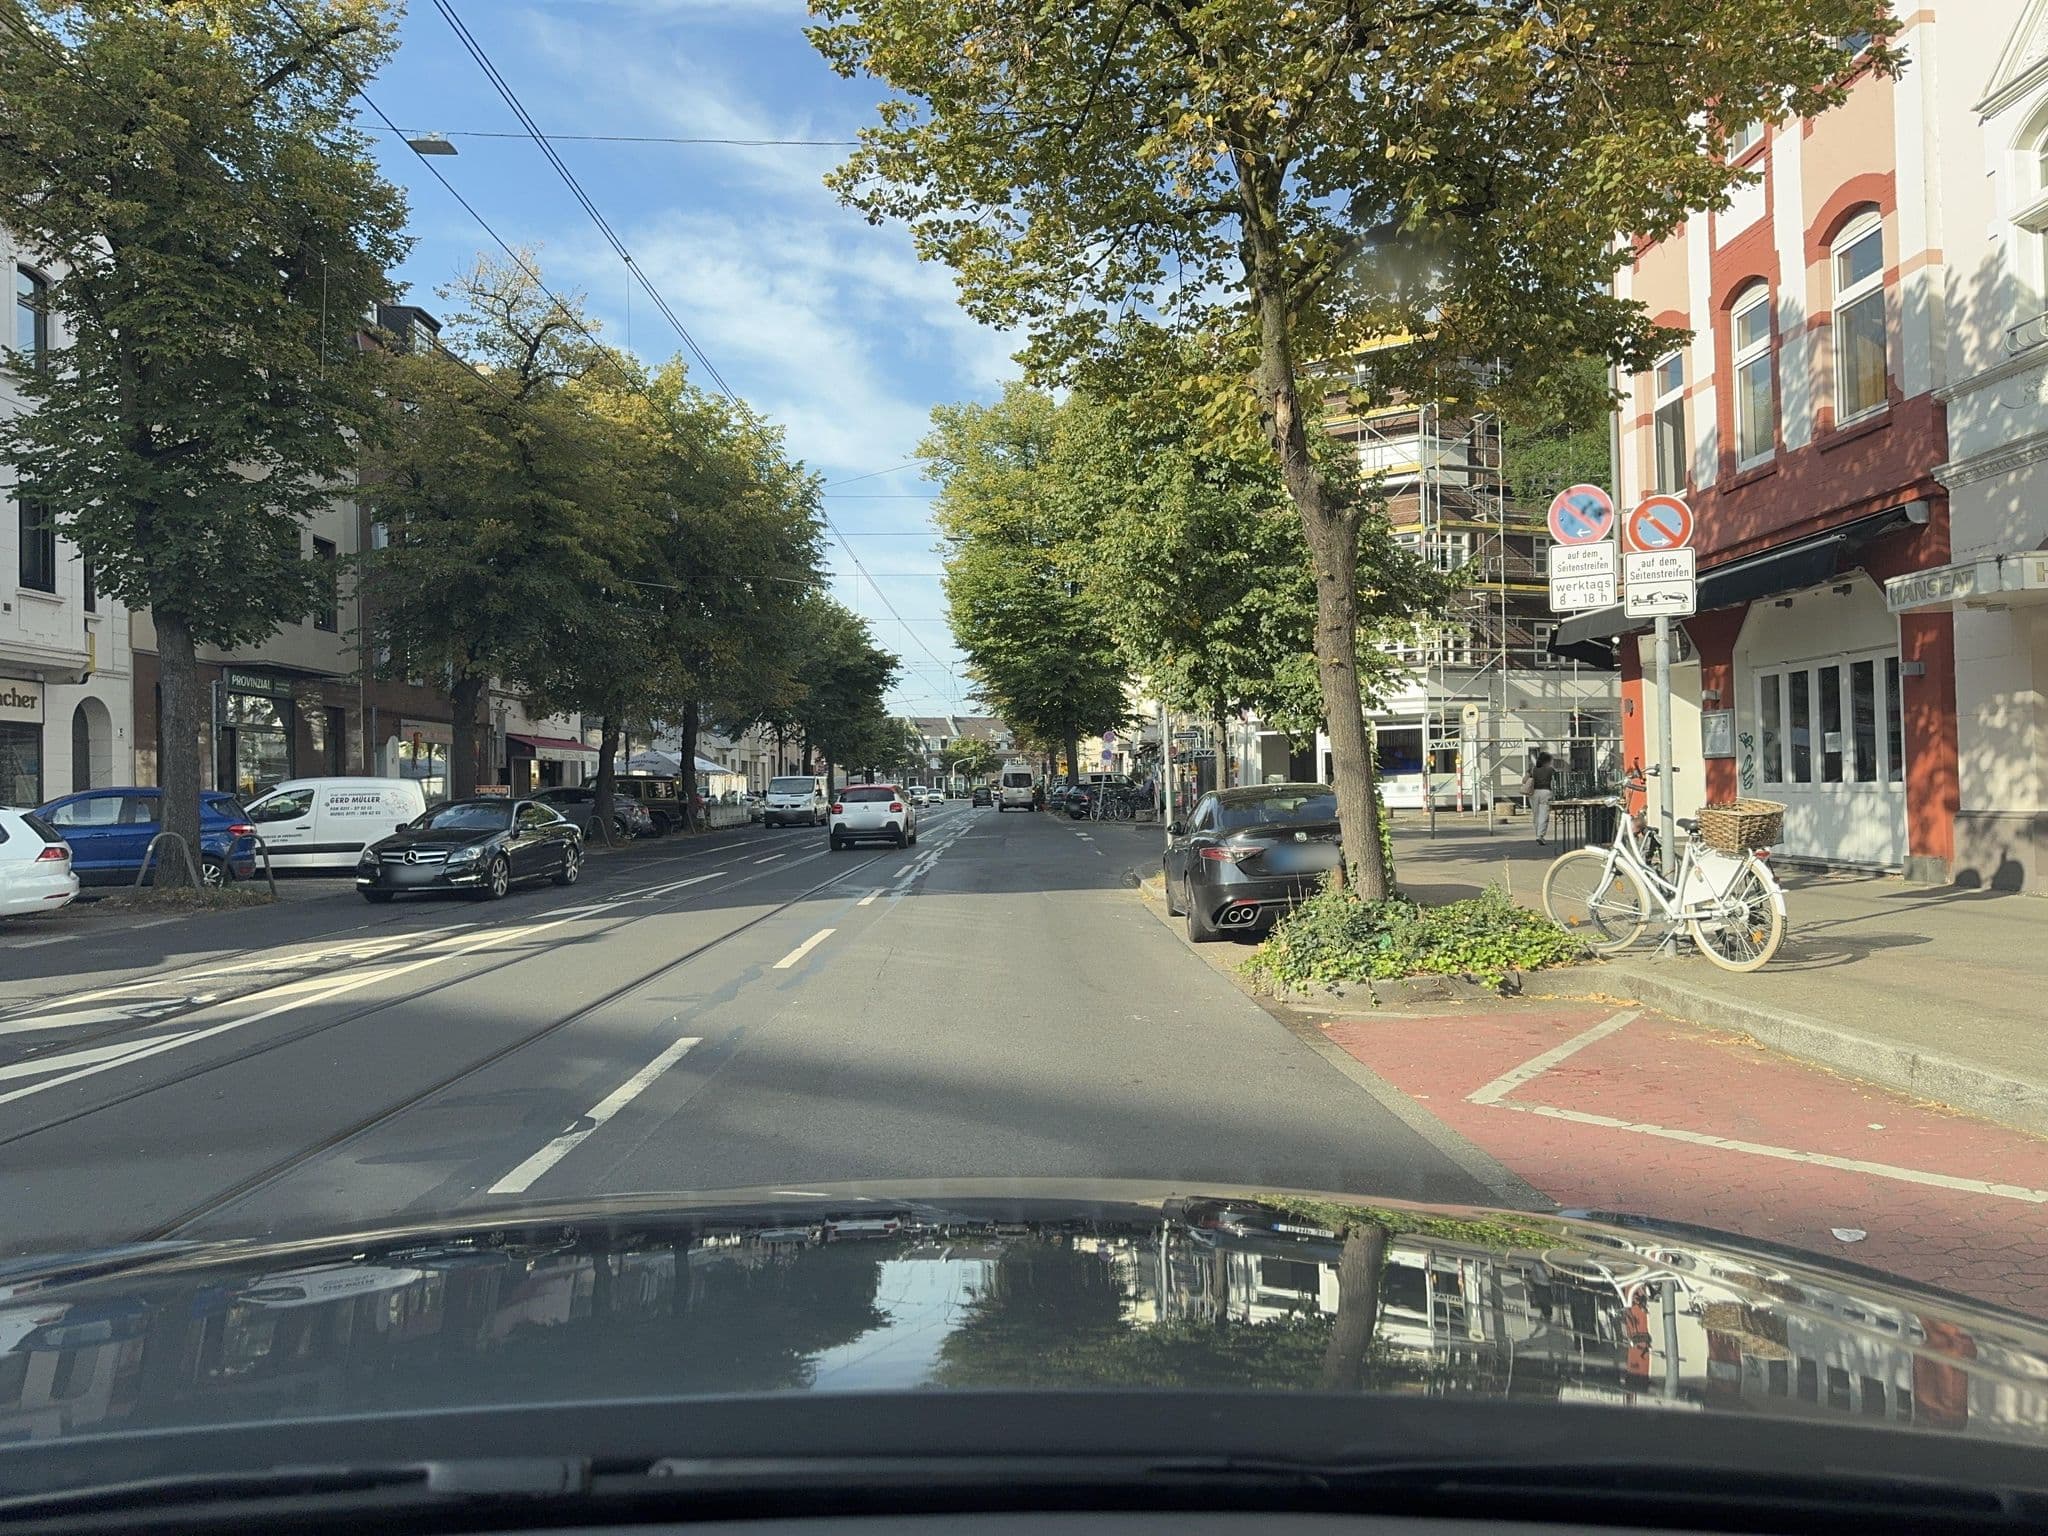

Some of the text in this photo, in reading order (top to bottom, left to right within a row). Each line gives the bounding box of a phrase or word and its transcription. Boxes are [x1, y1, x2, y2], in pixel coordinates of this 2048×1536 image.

[1567, 549, 1598, 560] auf dem
[1557, 560, 1609, 573] Seitenstreifen
[1641, 557, 1677, 568] auf dem
[1630, 567, 1689, 581] Seitenstreifen
[1556, 579, 1611, 592] werktags
[1889, 569, 1974, 606] HANSEAT
[1559, 593, 1566, 606] 8
[1583, 593, 1595, 603] 18
[1600, 592, 1608, 603] h
[231, 674, 271, 689] PROVINZIAL
[352, 795, 380, 803] MÜLLER
